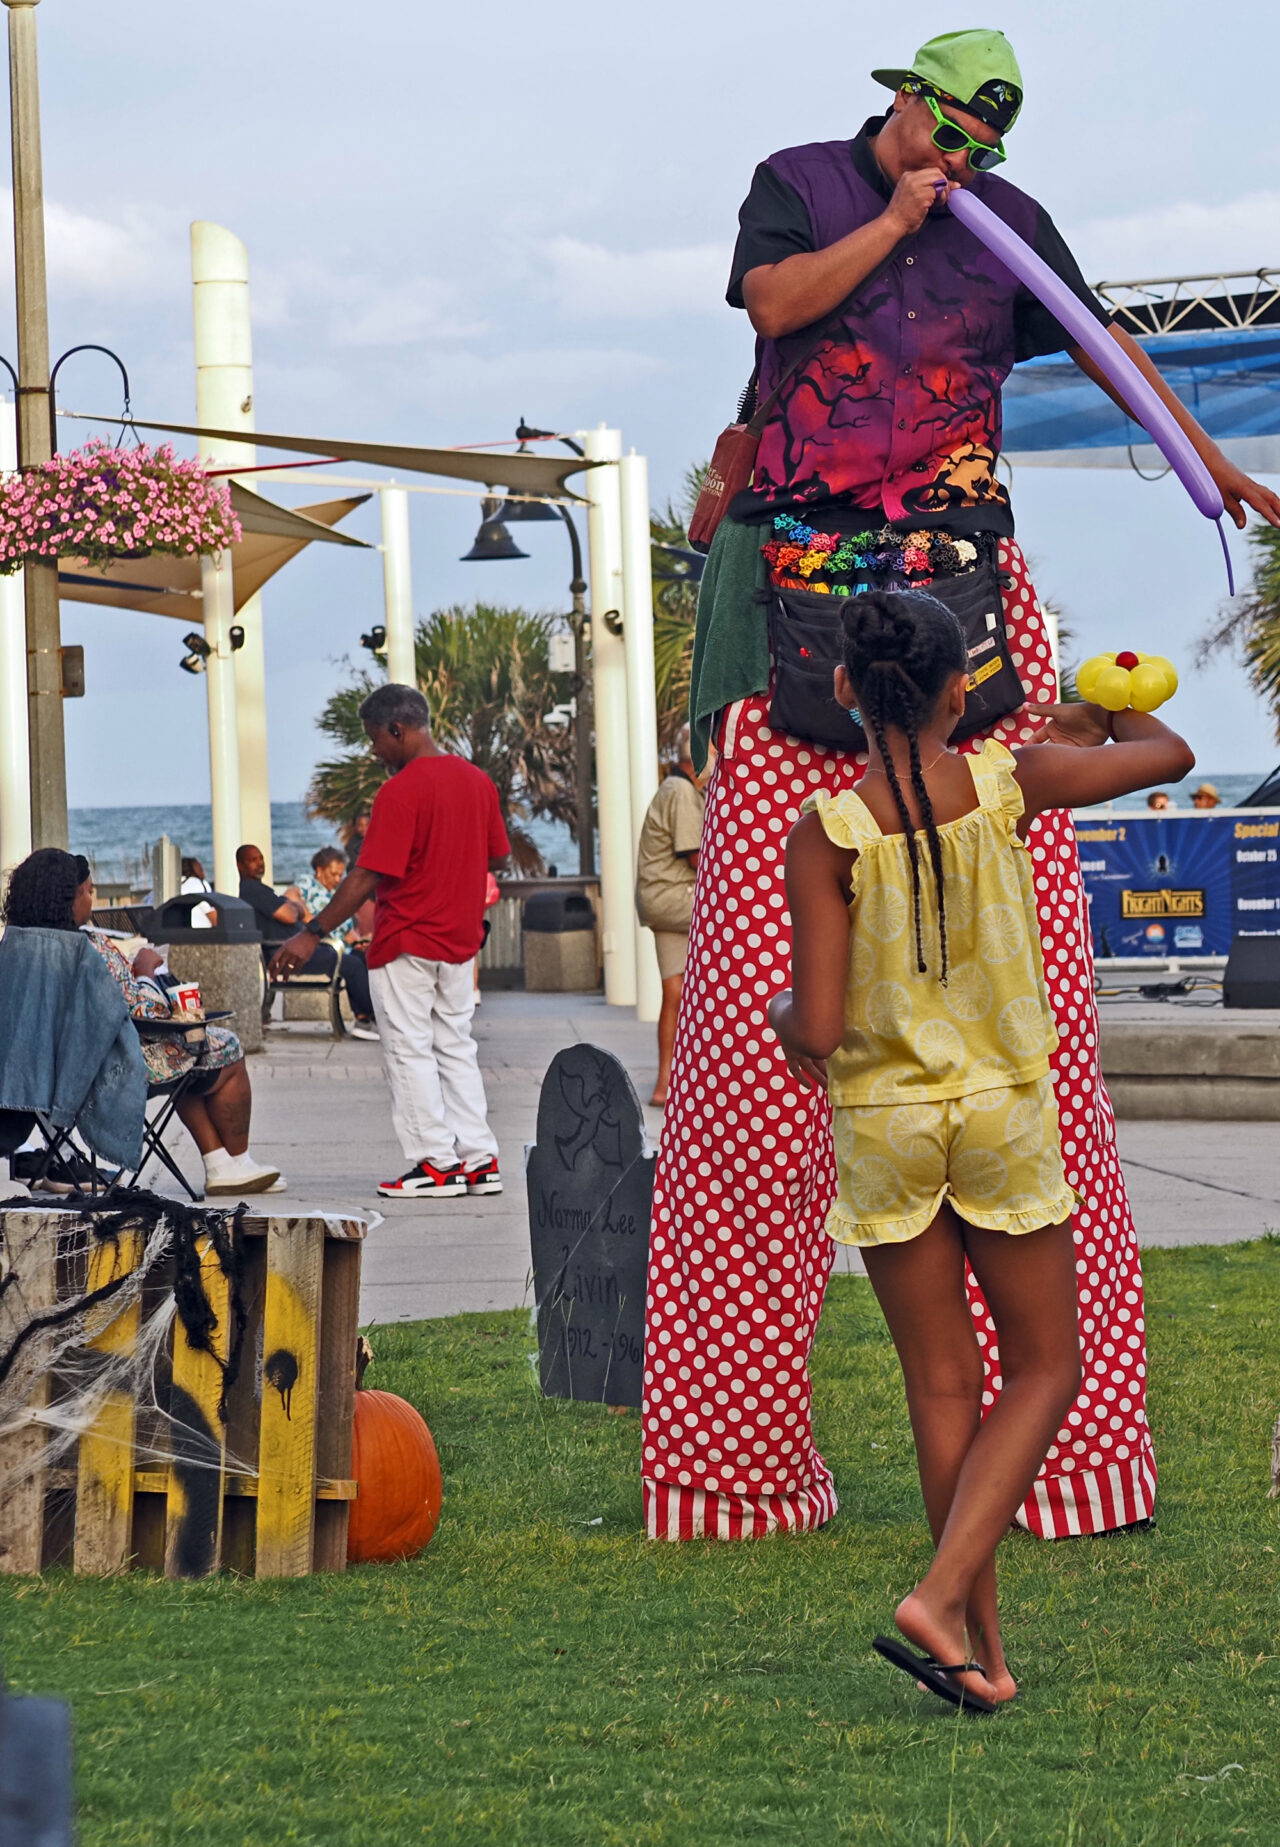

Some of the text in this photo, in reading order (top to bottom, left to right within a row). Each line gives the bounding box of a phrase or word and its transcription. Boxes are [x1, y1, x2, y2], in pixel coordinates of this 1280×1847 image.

[1234, 822, 1280, 839] Special
[1236, 849, 1267, 863] October
[1238, 898, 1275, 911] November
[537, 1189, 637, 1236] Norma Lee
